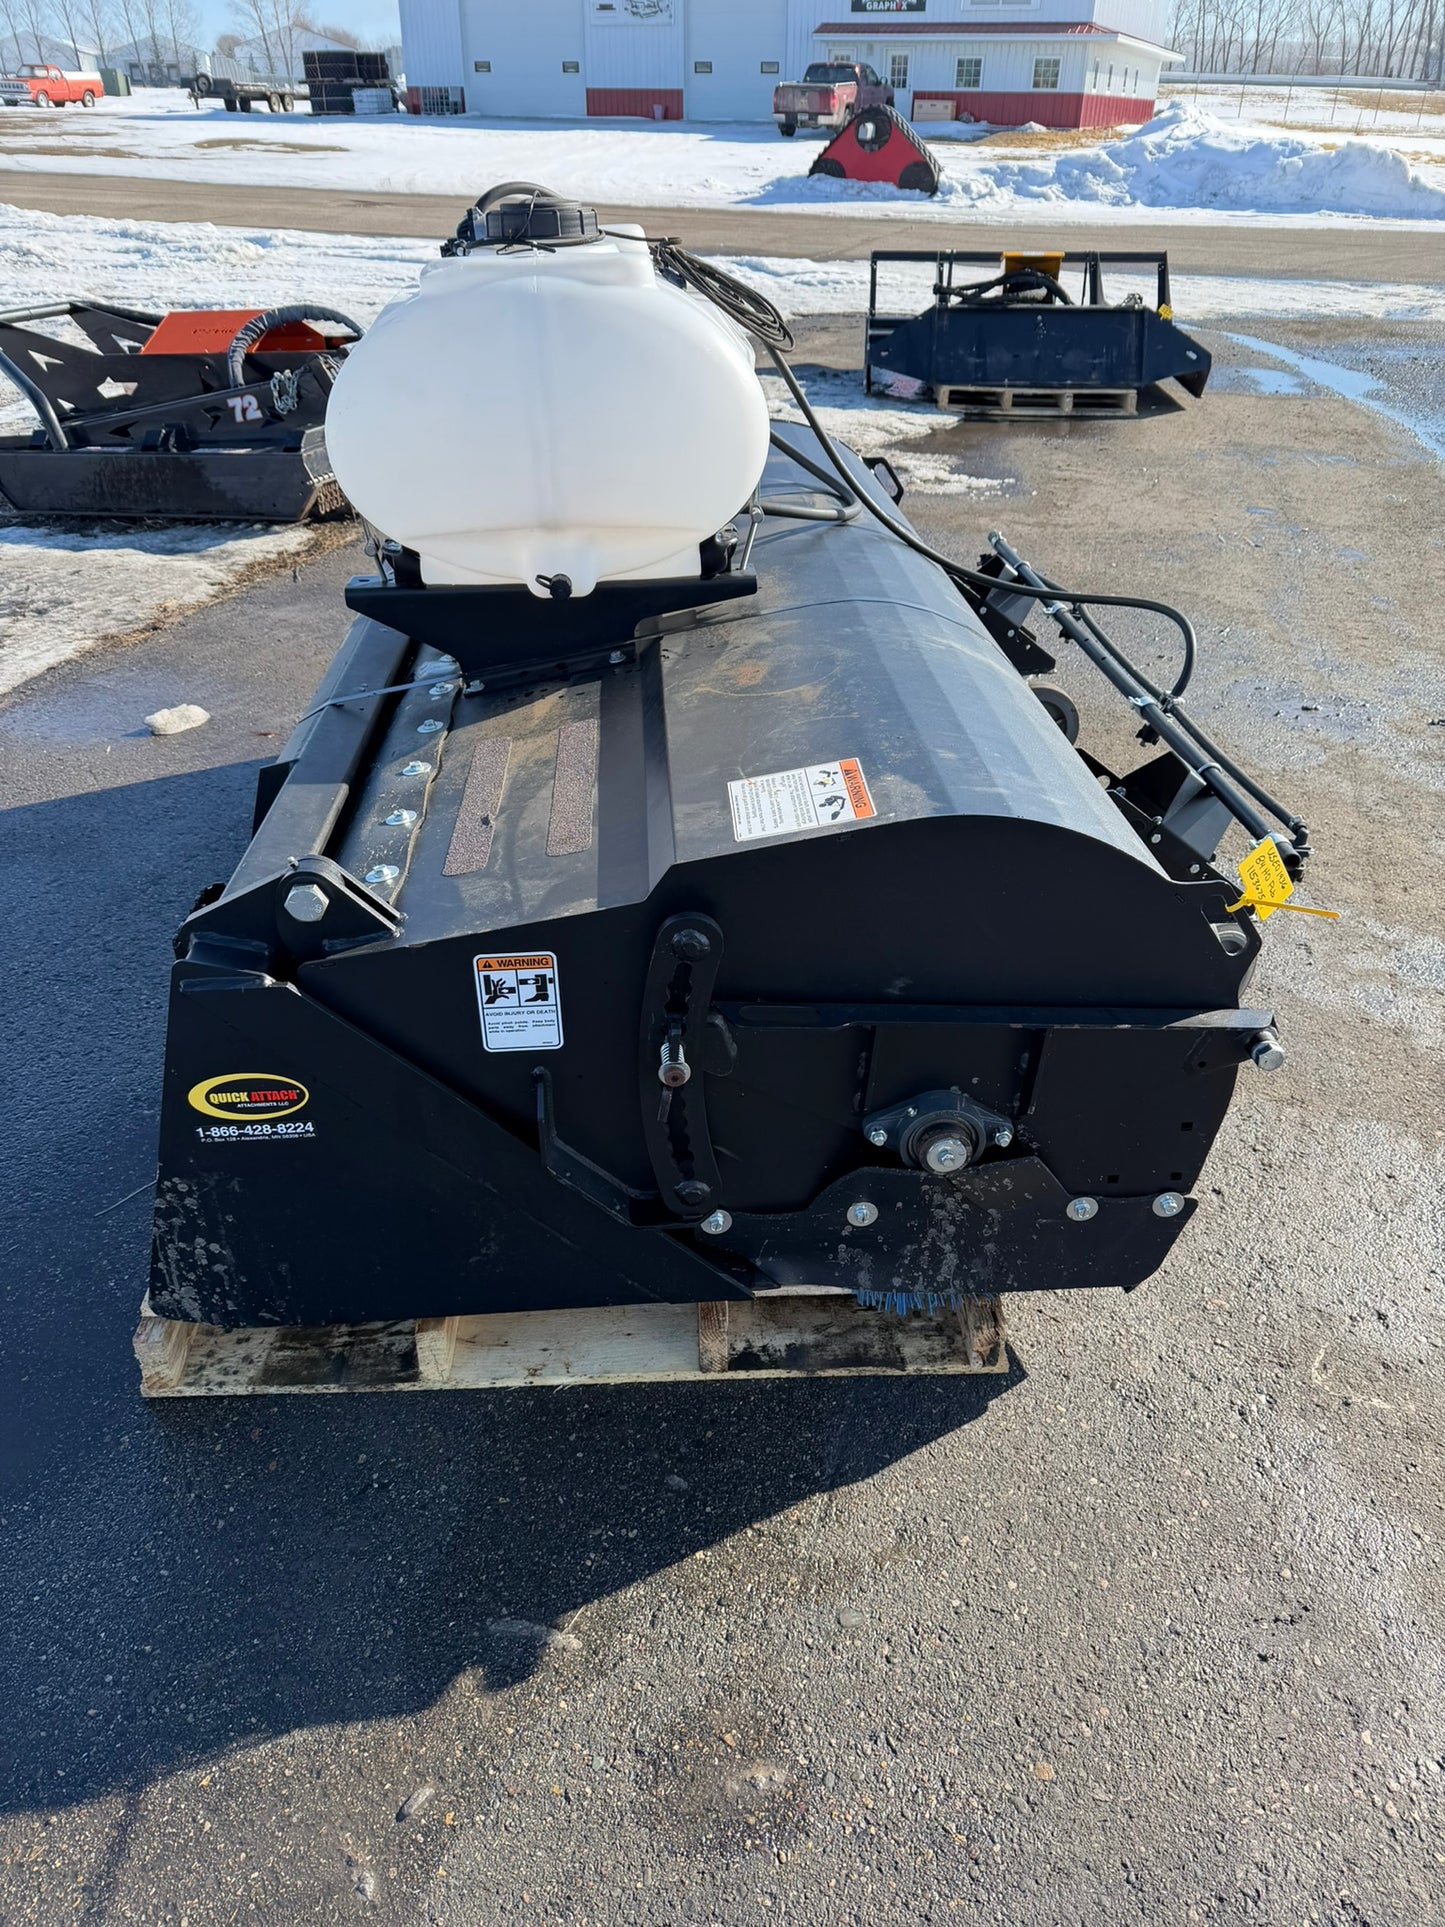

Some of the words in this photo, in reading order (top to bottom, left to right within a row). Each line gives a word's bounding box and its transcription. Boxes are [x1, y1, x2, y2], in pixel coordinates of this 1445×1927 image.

[226, 394, 264, 423] 72
[847, 773, 867, 809] WARNING
[1267, 847, 1281, 872] USED
[497, 958, 549, 968] WARNING
[209, 1092, 249, 1104] QUICK
[251, 1090, 298, 1101] ATTACH
[196, 1122, 314, 1137] 1-866-428-8224
